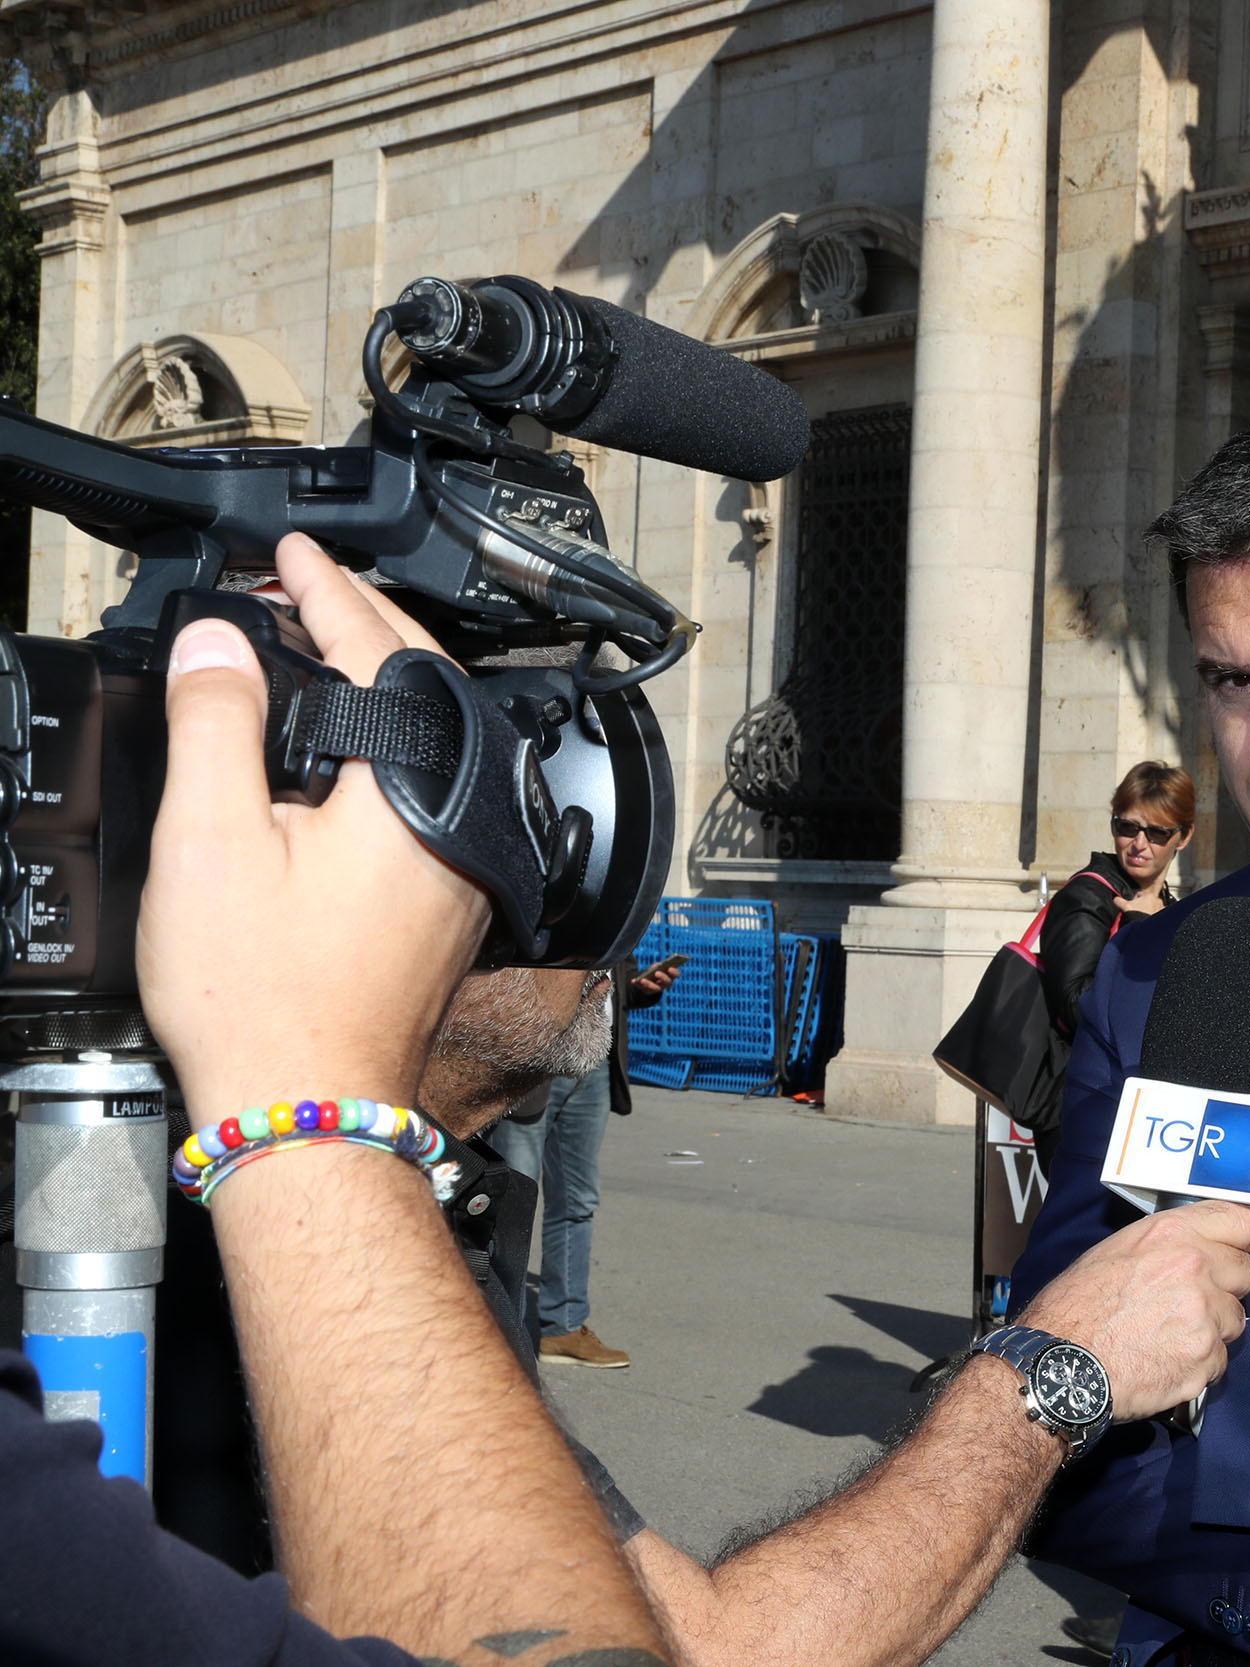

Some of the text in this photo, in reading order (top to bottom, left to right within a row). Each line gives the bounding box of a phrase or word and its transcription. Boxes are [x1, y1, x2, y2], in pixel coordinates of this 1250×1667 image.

[31, 715, 60, 728] OPTION
[32, 791, 62, 803] SDI OUT
[30, 865, 41, 875] TC
[30, 876, 46, 886] OUT
[36, 902, 45, 912] IN
[31, 915, 48, 926] OUT
[27, 942, 62, 953] GENLOCK
[27, 953, 67, 963] VIDEO OUT
[112, 1097, 164, 1117] LAMPO
[1145, 1116, 1226, 1159] TGR
